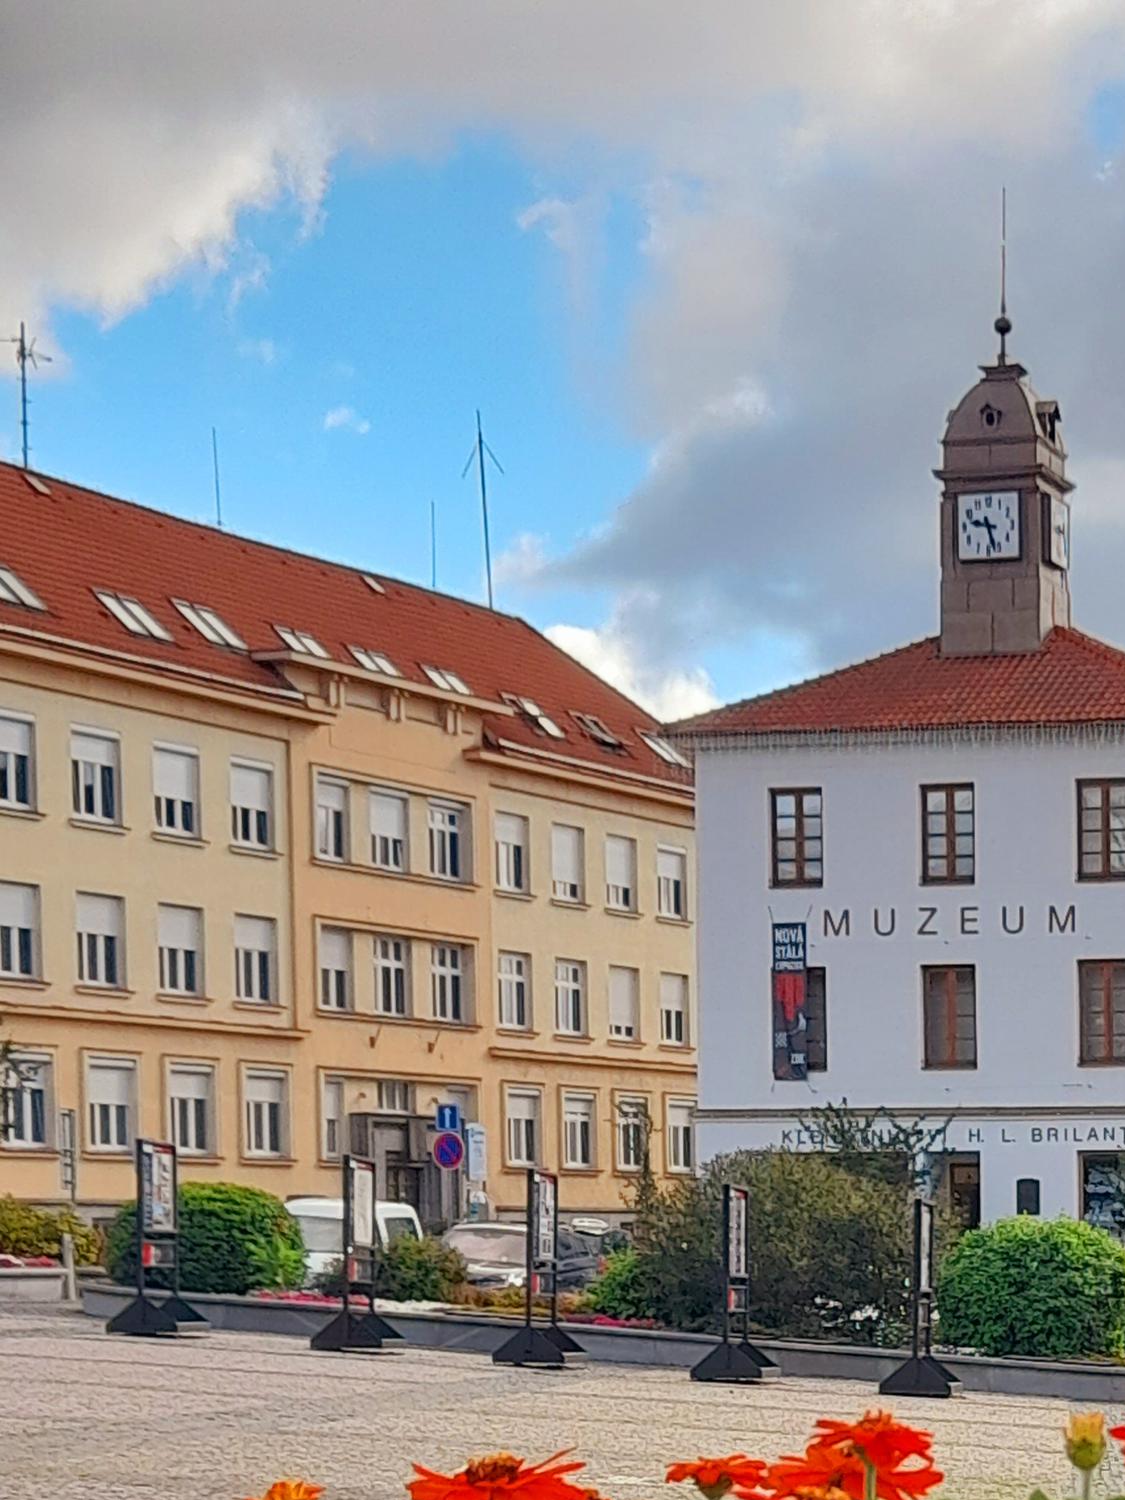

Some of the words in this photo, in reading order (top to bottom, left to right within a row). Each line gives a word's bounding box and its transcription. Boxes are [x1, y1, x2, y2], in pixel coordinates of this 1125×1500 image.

[823, 905, 1075, 936] MUZEUM
[775, 925, 803, 943] NOVÁ
[968, 1128, 984, 1143] H.
[1002, 1128, 1016, 1143] L.
